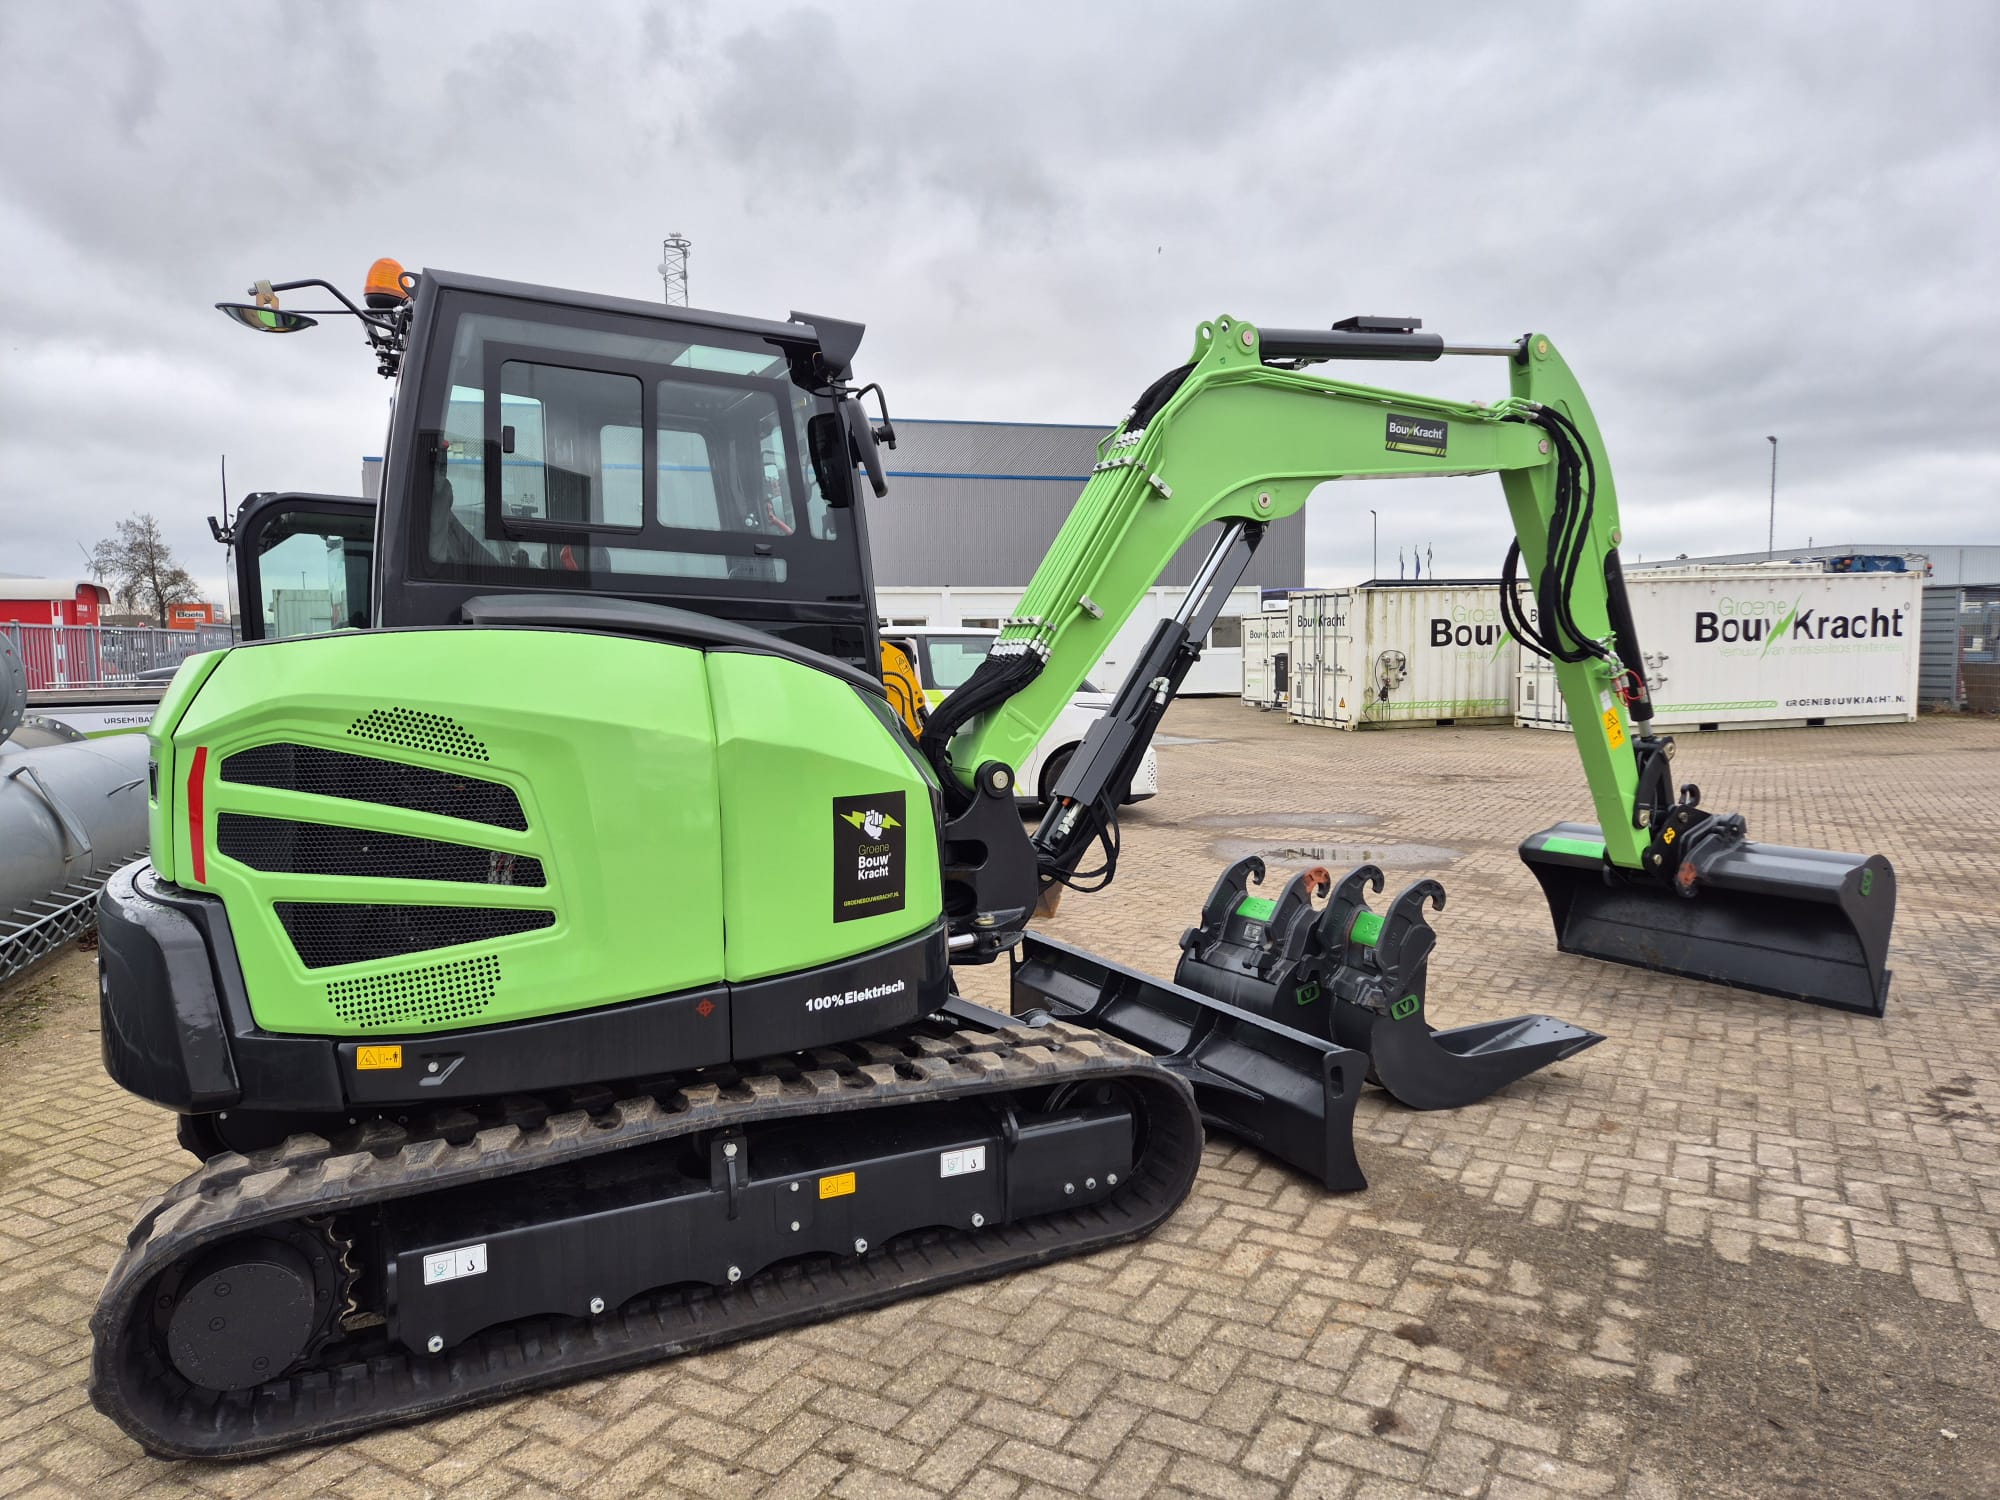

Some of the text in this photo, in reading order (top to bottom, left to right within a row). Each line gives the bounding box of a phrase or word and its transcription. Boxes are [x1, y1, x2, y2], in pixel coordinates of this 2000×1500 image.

[858, 843, 890, 856] Groene
[858, 855, 889, 869] Bouw
[857, 866, 889, 881] Kracht
[843, 891, 900, 907] GROENEBOUWKRACHT.NL
